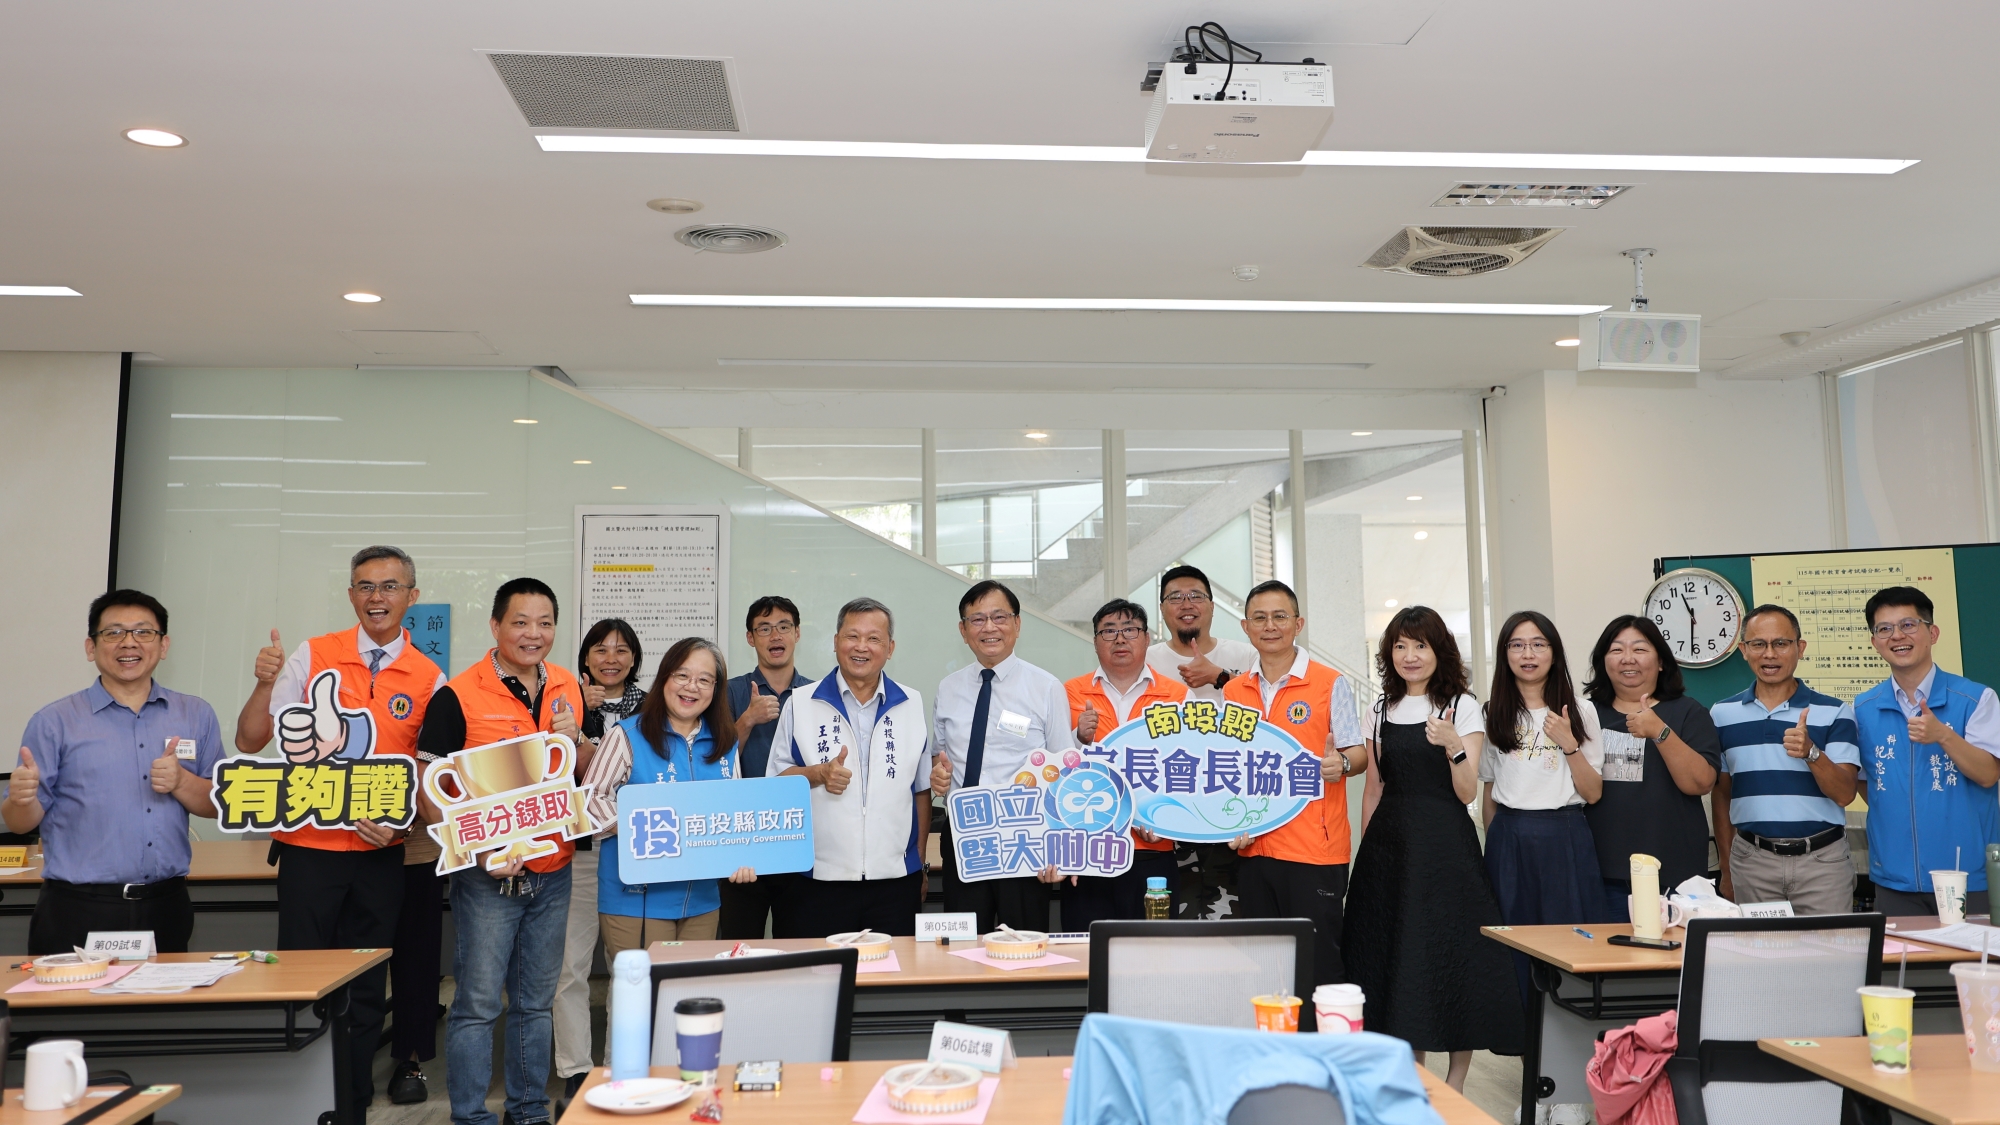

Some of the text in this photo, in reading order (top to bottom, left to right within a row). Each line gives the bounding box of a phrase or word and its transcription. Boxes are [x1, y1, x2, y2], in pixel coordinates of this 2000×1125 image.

[1669, 587, 1678, 598] 11
[1683, 582, 1695, 593] 12
[1703, 585, 1709, 596] 1
[1659, 599, 1671, 610] 10
[1715, 595, 1724, 606] 2
[1655, 614, 1664, 625] 9
[1723, 611, 1731, 622] 3
[1662, 629, 1670, 641] 8
[1719, 627, 1727, 638] 4
[1677, 641, 1685, 652] 7
[1692, 643, 1700, 655] 6
[1707, 639, 1716, 650] 5
[1144, 702, 1260, 742] 南投縣
[832, 714, 841, 745] 副縣長
[882, 715, 898, 779] 南投縣政府
[1885, 734, 1897, 760] 科長
[719, 756, 731, 780] 南投
[1874, 745, 1887, 791] 紀忠良
[1929, 754, 1944, 792] 教育處
[221, 763, 410, 824] 有夠讚
[953, 785, 1044, 831] 國立
[455, 789, 574, 847] 高分錄取
[684, 808, 804, 836] 南投縣政府
[685, 832, 806, 848] Nantou County Government
[959, 831, 1127, 875] 暨大附中
[924, 921, 969, 932] 第05試場
[93, 939, 142, 951] 第09試場
[940, 1035, 993, 1057] 第06試場
